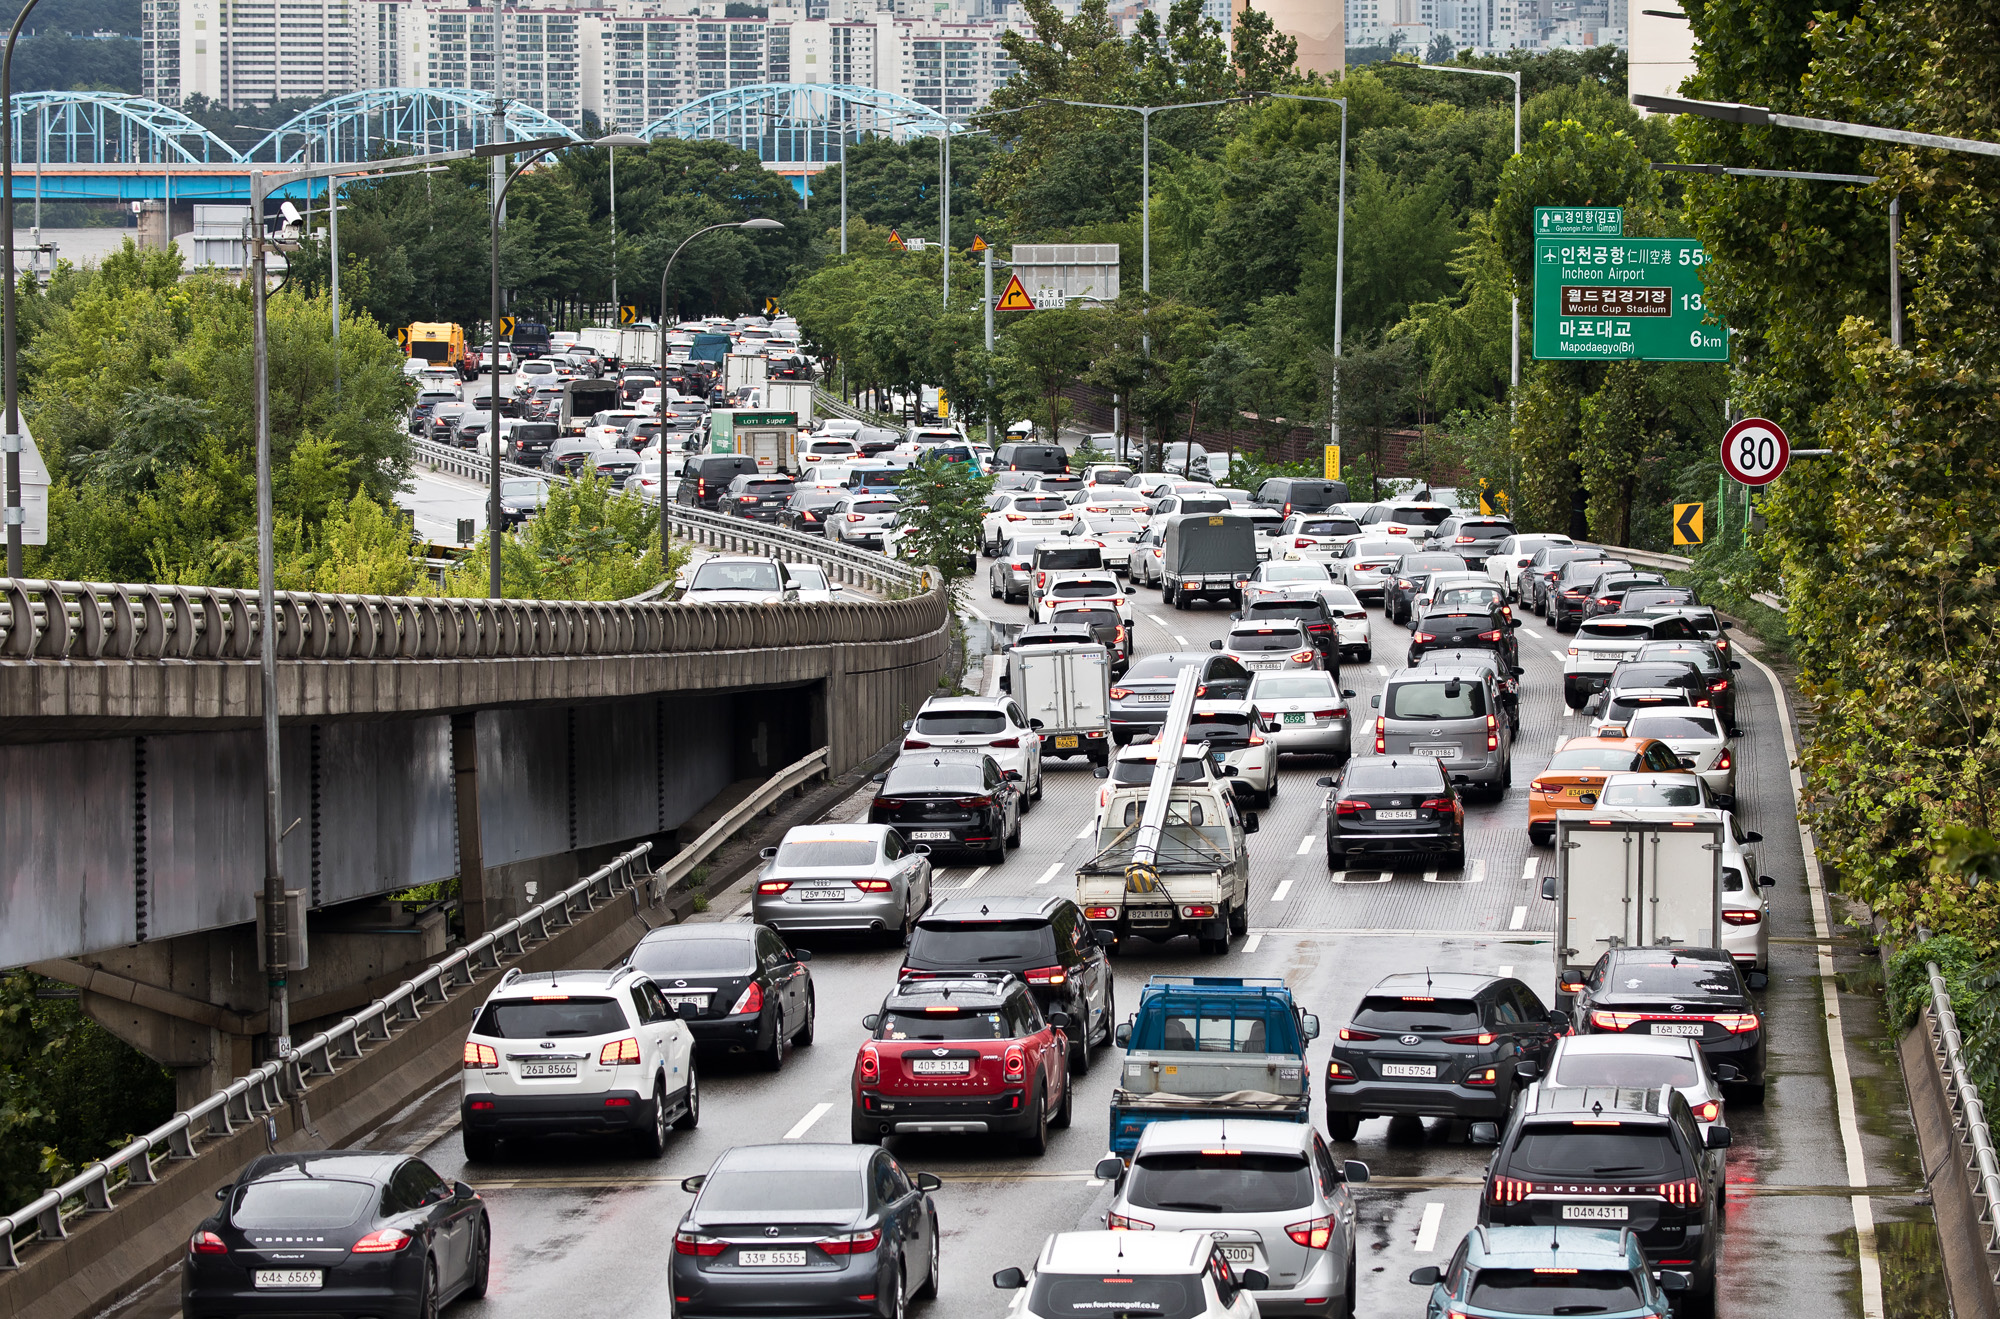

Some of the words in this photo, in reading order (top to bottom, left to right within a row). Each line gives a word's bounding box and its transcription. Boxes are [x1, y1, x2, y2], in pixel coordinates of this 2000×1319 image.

[1565, 210, 1620, 224] 경인항(김포)
[1555, 224, 1581, 233] Gyeongin
[1596, 223, 1618, 234] (Gimpo)
[1561, 246, 1625, 265] 인천공항
[1627, 248, 1672, 265] 仁川空港
[1562, 267, 1603, 280] Incheon
[1608, 267, 1645, 282] Airport
[1038, 289, 1064, 299] 속도를
[1566, 289, 1667, 304] 월드컵경기장
[1038, 299, 1065, 308] 줄이시오
[1568, 304, 1598, 313] World
[1602, 304, 1622, 314] Cup
[1626, 304, 1667, 314] Stadium
[1559, 319, 1632, 339] 마포대교
[1560, 341, 1635, 354] Mapodaegyo(Br)
[1739, 436, 1775, 471] 80
[1284, 714, 1305, 724] 6593
[1395, 811, 1413, 819] 5445
[822, 890, 841, 898] 7967
[1150, 910, 1169, 918] 1416
[1676, 1025, 1699, 1034] 3226
[280, 1044, 290, 1052] 04
[548, 1064, 572, 1074] 8566
[940, 1061, 964, 1071] 5134
[1408, 1066, 1432, 1076] 5754
[1597, 1206, 1623, 1218] 4311
[771, 1252, 801, 1264] 5535
[261, 1271, 283, 1283] 64소
[288, 1271, 317, 1283] 6569
[1072, 1300, 1161, 1311] www.fourteengolf.co.kr
